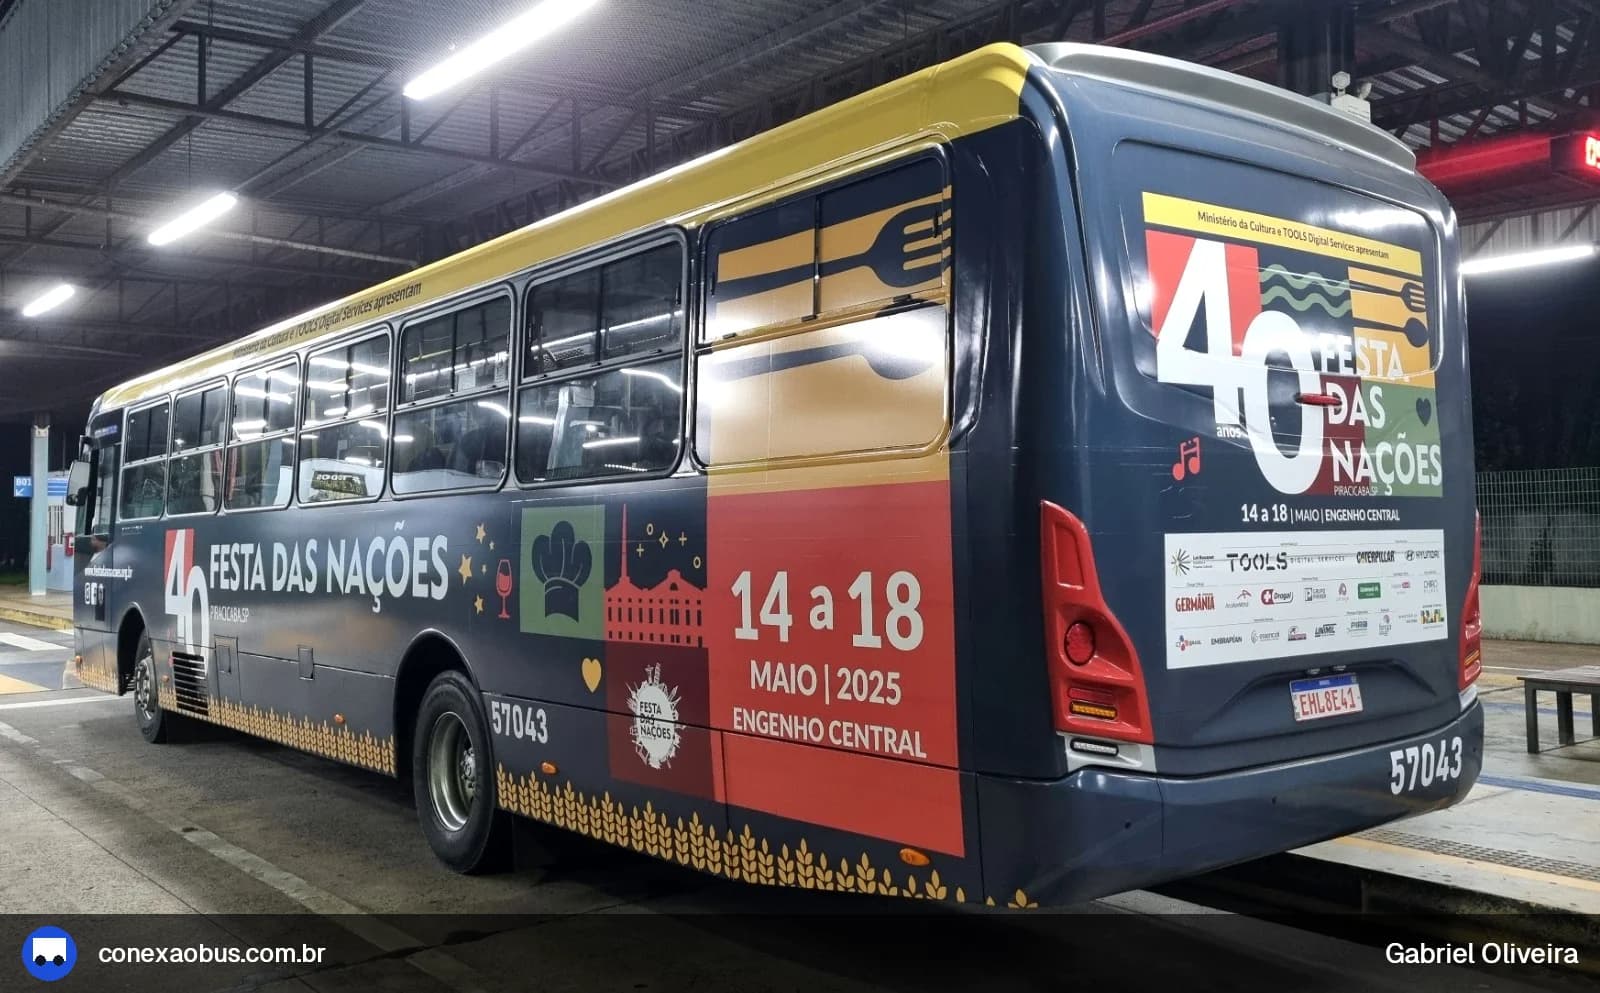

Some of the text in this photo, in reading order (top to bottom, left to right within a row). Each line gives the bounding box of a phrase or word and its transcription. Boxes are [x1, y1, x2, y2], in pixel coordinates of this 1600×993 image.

[1197, 210, 1390, 260] Ministério da Cultura e TOOLS Digital Services apresentam
[342, 300, 372, 321] Services
[373, 282, 422, 312] apresentam
[1156, 237, 1324, 495] 40
[1319, 332, 1405, 380] FESTA
[1326, 382, 1386, 428] DAS
[1216, 425, 1242, 439] anos
[1329, 433, 1442, 496] NAÇÕES
[1241, 504, 1258, 523] 14
[1260, 508, 1269, 523] a
[1271, 504, 1288, 523] 18
[1295, 508, 1319, 523] MAIO
[1325, 508, 1366, 522] ENGENHO
[1366, 508, 1401, 522] CENTRAL
[209, 519, 449, 614] FESTA DAS NAÇÕES
[1226, 552, 1288, 572] TOOLS
[1356, 550, 1396, 564] CATERPILLAR
[731, 570, 924, 651] 14 a 18
[750, 659, 818, 697] MAIO
[836, 667, 902, 706] 2025
[1300, 687, 1357, 716] EHL8E41
[490, 700, 549, 744] 57043
[638, 700, 663, 716] FESTA
[639, 712, 657, 726] DAS
[639, 724, 673, 742] NAÇÕES
[733, 706, 927, 759] ENGENHO CENTRAL
[1390, 736, 1463, 795] 57043
